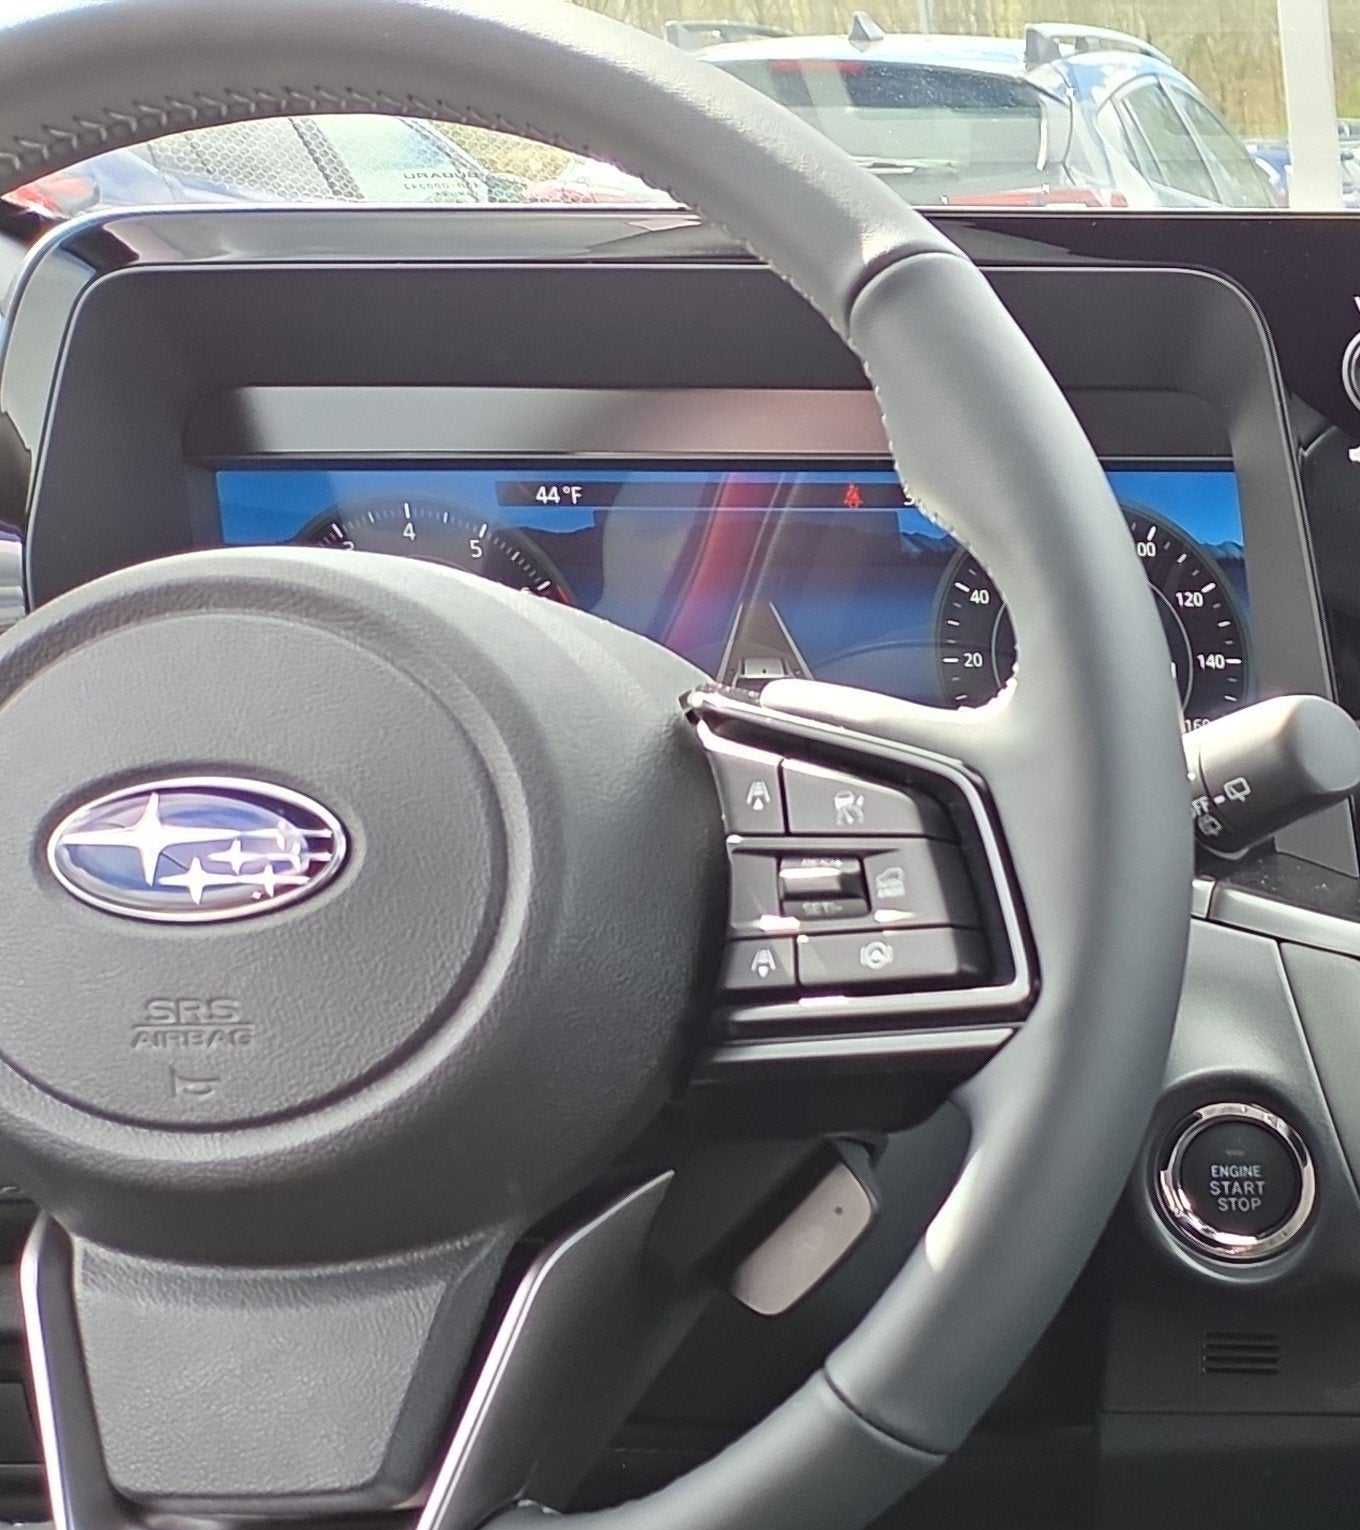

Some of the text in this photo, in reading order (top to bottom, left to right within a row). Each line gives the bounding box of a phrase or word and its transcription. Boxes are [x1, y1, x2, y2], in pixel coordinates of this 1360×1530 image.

[535, 486, 583, 506] 44°F
[402, 521, 416, 541] 4
[469, 539, 483, 559] 5
[969, 588, 990, 605] 40
[1175, 592, 1204, 607] 120
[963, 653, 983, 668] 20
[1196, 653, 1225, 670] 140
[145, 997, 241, 1024] SRS
[130, 1028, 253, 1048] AIRBAG
[1210, 1164, 1262, 1178] ENGINE
[1209, 1180, 1266, 1196] START
[1217, 1197, 1262, 1212] STOP
